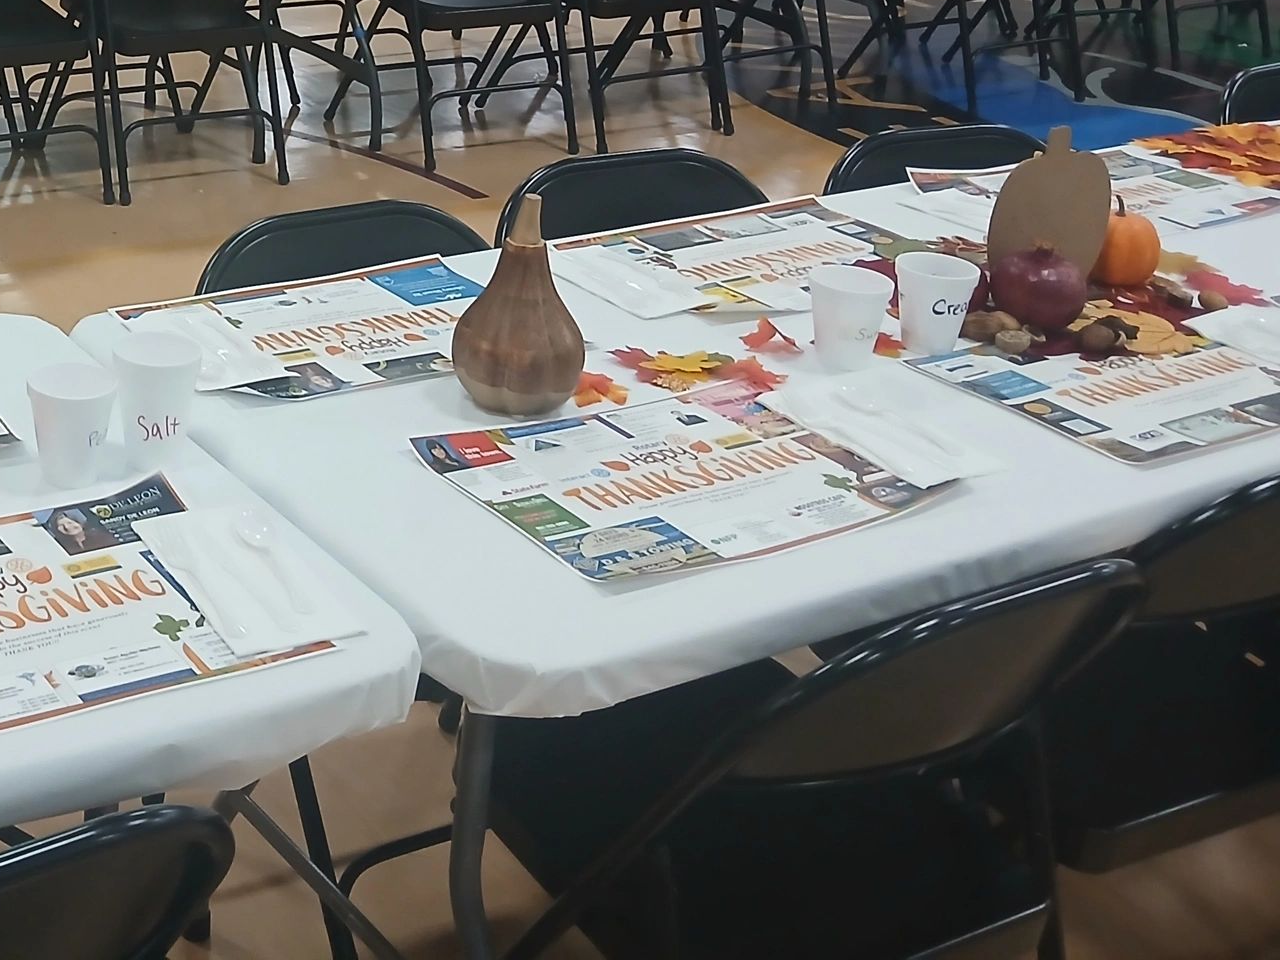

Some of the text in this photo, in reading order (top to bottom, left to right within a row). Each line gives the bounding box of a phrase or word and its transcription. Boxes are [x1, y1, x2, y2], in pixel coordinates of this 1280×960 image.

[342, 335, 406, 355] Happy
[137, 415, 180, 442] Salt
[619, 443, 699, 468] Happy
